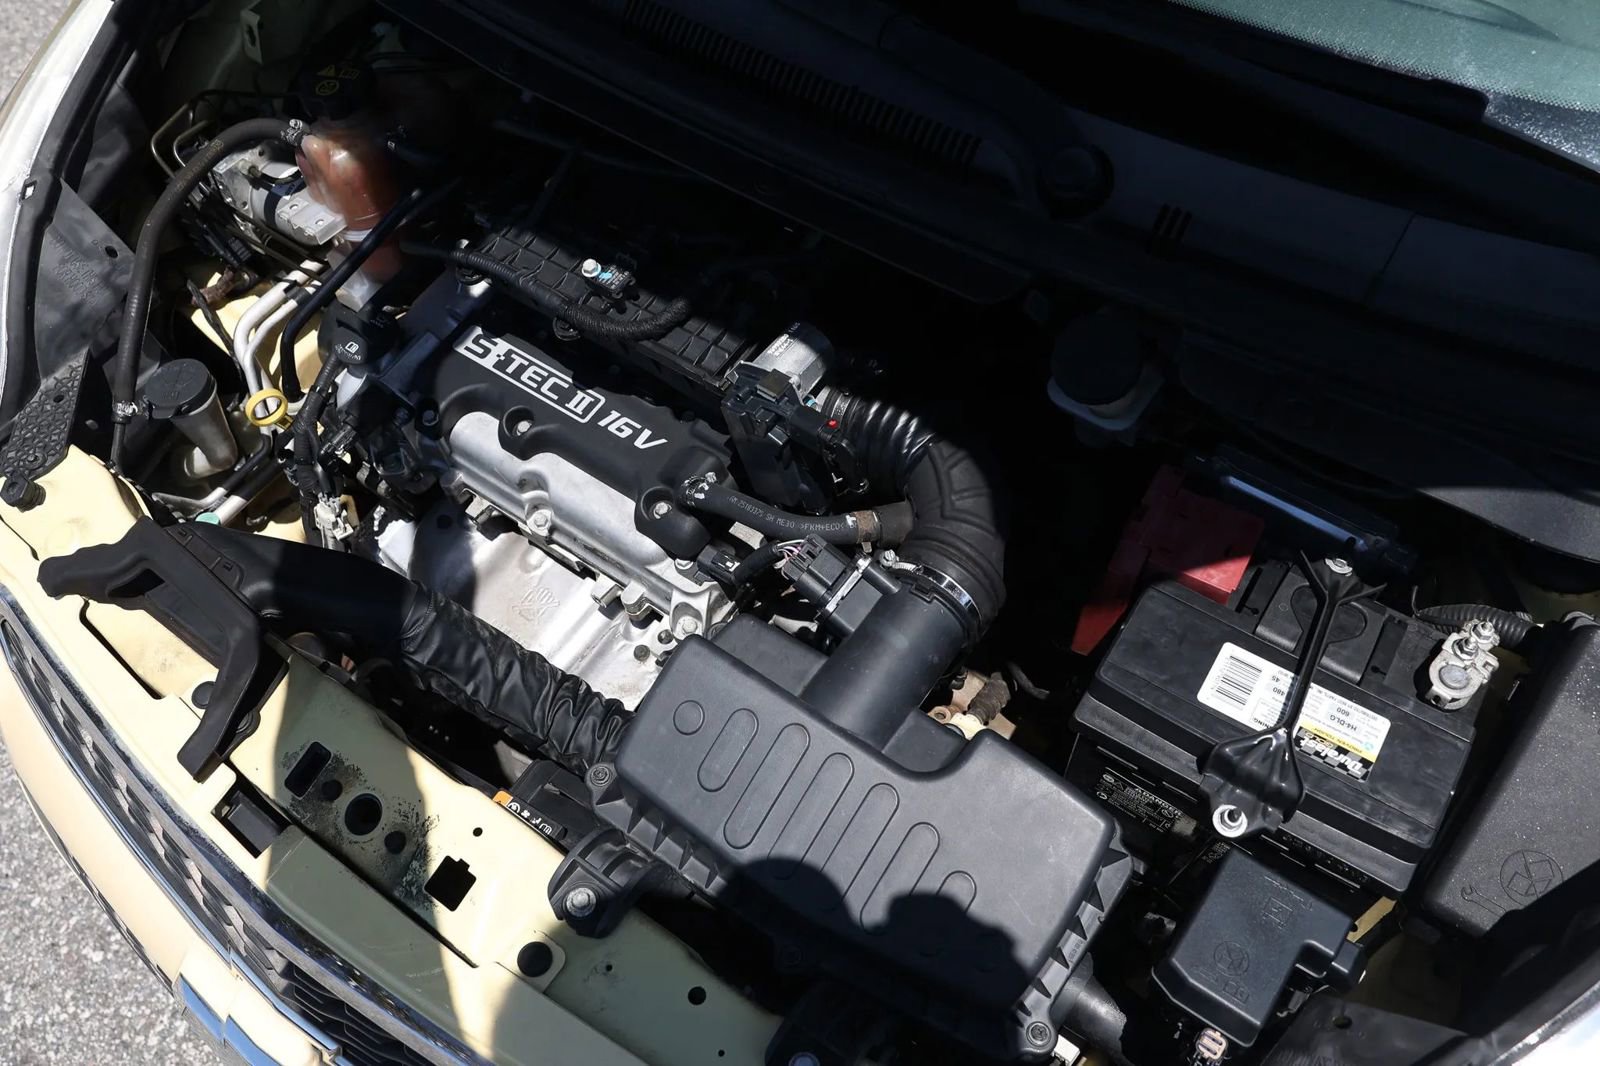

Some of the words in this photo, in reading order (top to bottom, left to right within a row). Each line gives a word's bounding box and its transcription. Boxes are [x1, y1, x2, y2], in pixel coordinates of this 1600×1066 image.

[597, 409, 668, 450] 16V
[1270, 674, 1281, 683] 45
[1271, 685, 1286, 697] 480
[1335, 705, 1350, 717] 600
[1329, 714, 1358, 731] H4-DLG
[1298, 737, 1362, 774] Duralast
